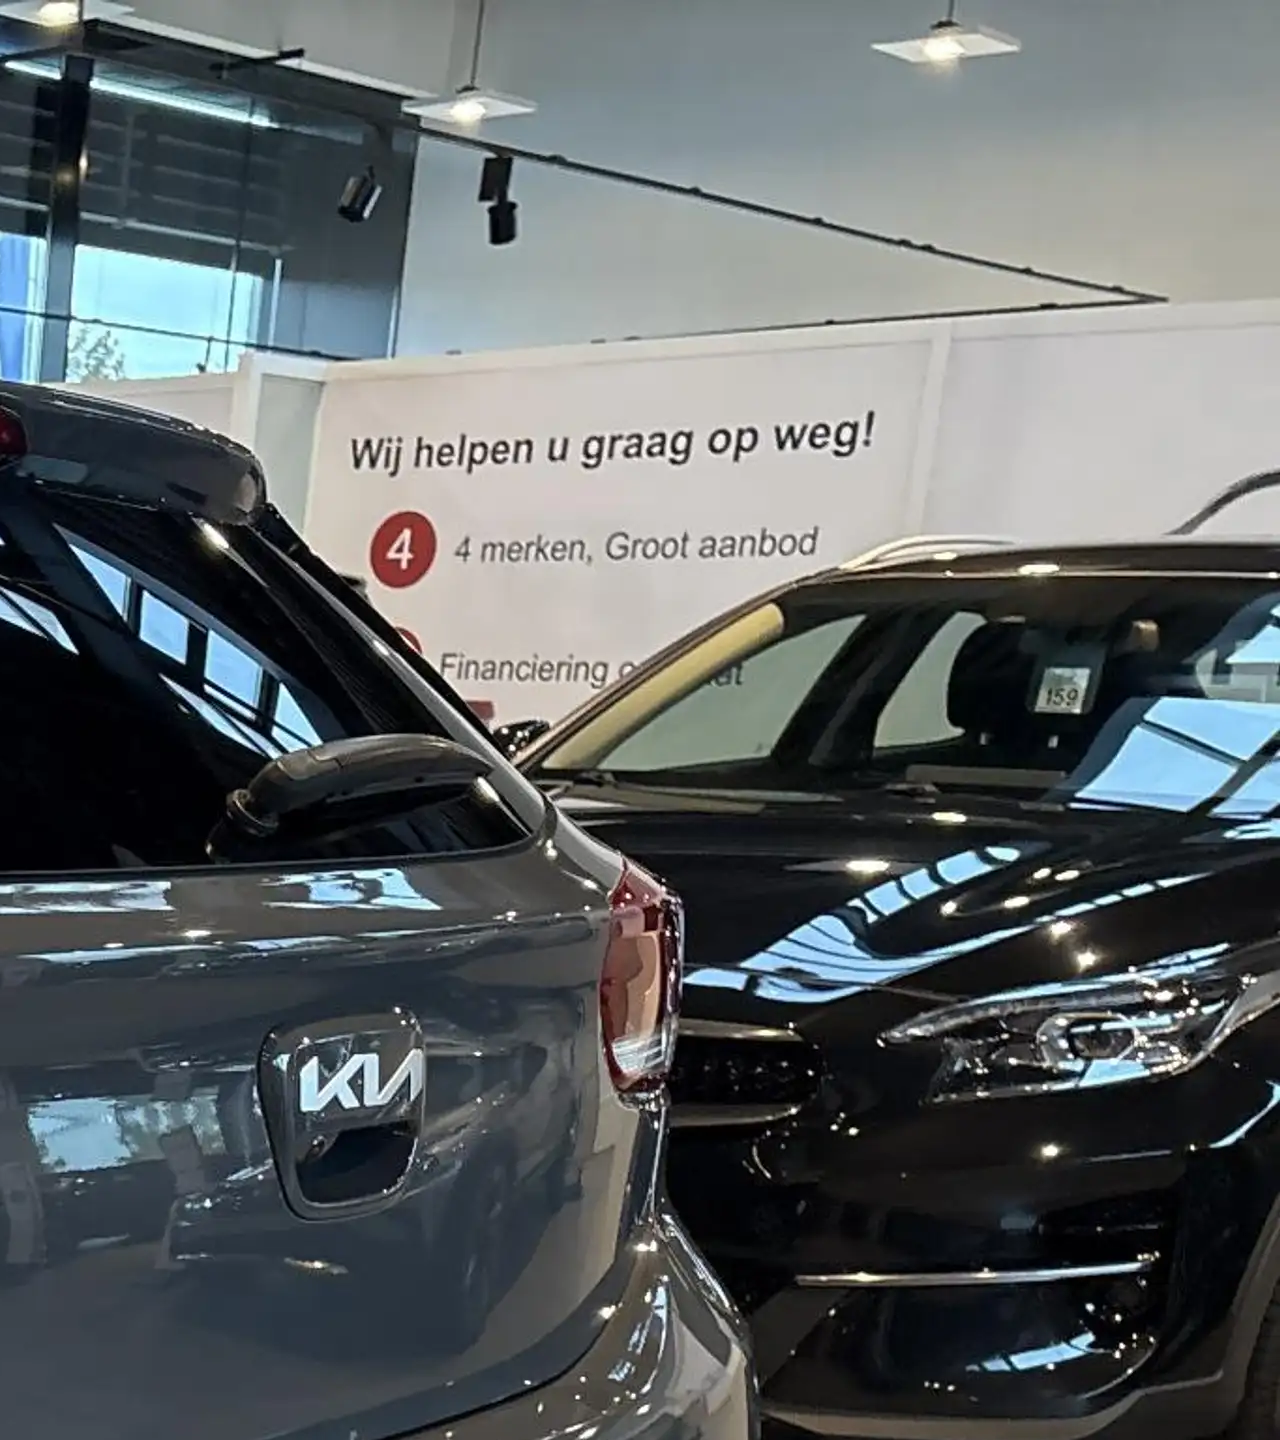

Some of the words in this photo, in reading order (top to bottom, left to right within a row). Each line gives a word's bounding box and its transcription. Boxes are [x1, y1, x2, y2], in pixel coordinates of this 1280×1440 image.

[351, 437, 403, 477] Wij
[413, 434, 534, 474] helpen
[547, 438, 570, 463] u
[581, 427, 694, 470] graag
[707, 424, 759, 463] op
[774, 410, 876, 460] weg!
[386, 528, 414, 570] 4
[454, 535, 473, 564] 4
[480, 533, 593, 566] merken,
[605, 529, 690, 562] Groot
[699, 526, 820, 560] aanbod
[440, 652, 609, 689] Financiering
[299, 1048, 423, 1113] KIA
